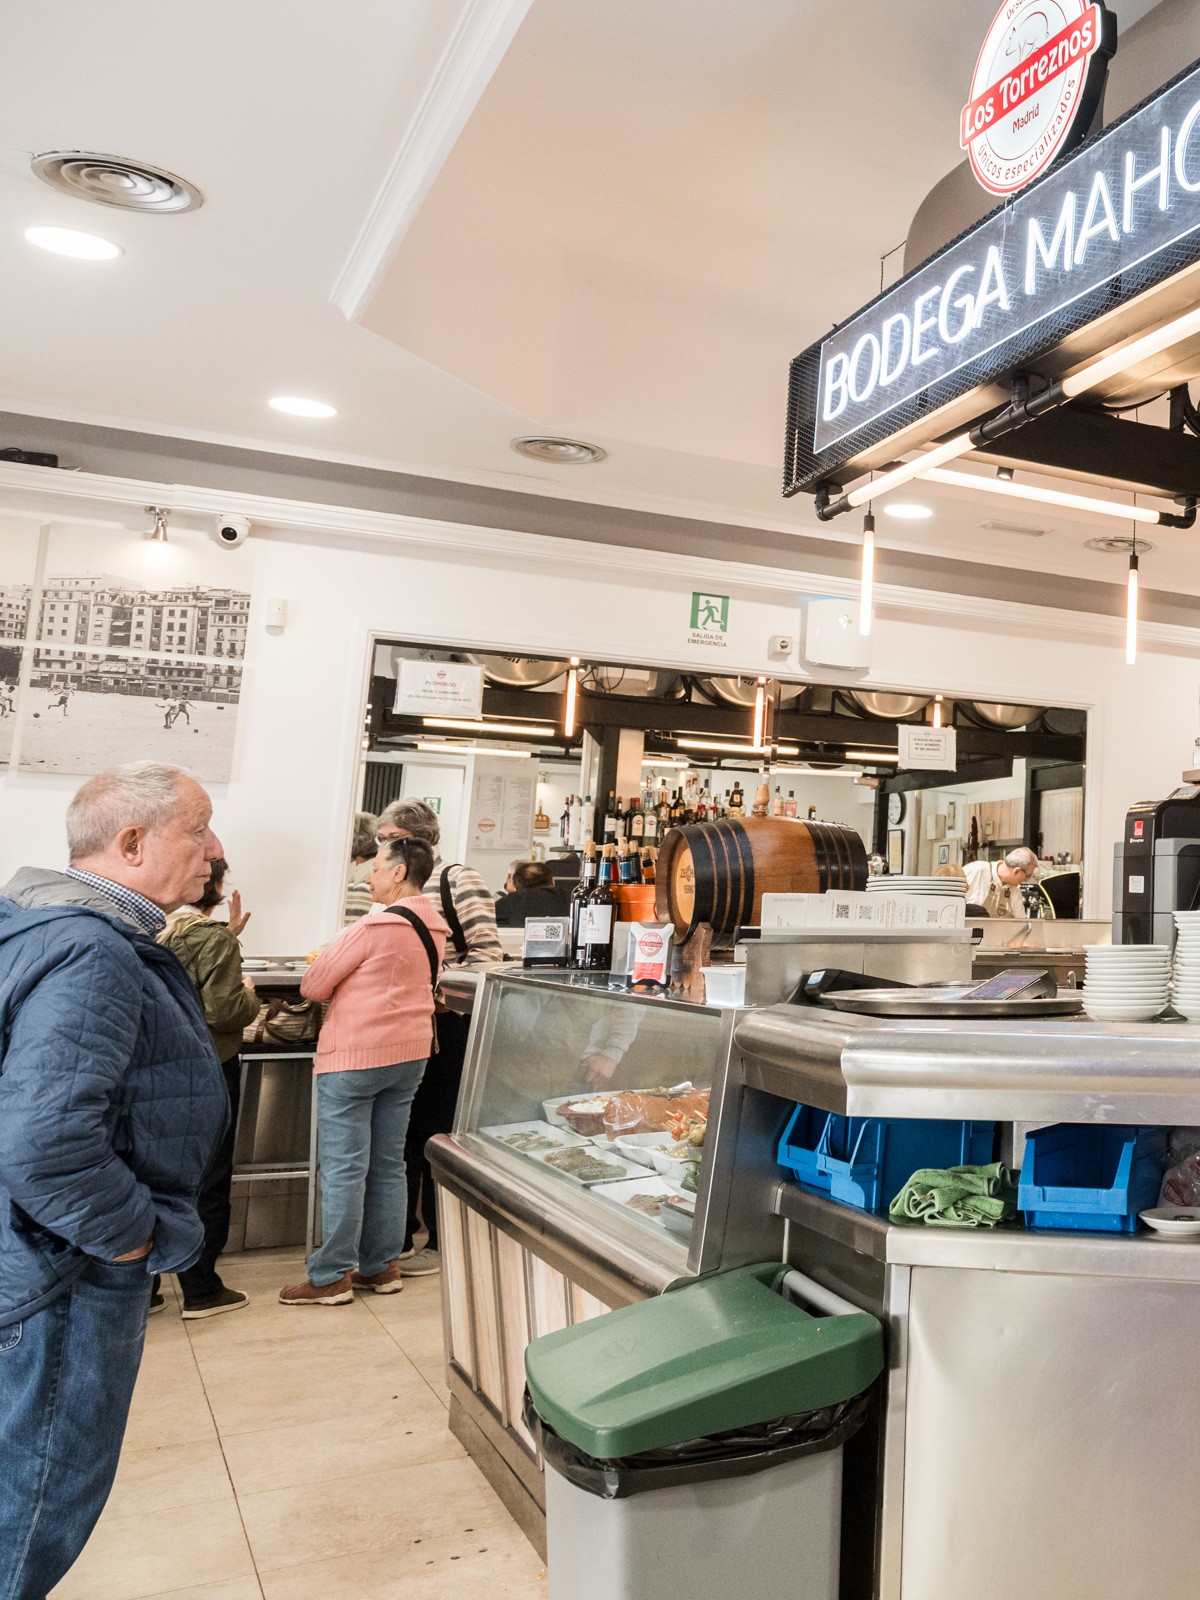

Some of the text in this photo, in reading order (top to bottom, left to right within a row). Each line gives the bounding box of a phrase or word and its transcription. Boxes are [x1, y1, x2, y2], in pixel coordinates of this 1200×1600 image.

[964, 20, 1092, 136] Los Torreznos
[978, 78, 1075, 180] únicos especializados
[1012, 103, 1040, 134] Madrid
[822, 244, 1010, 422] BODEGA
[687, 638, 728, 648] EMERGENCIA
[692, 632, 717, 640] SALIDA
